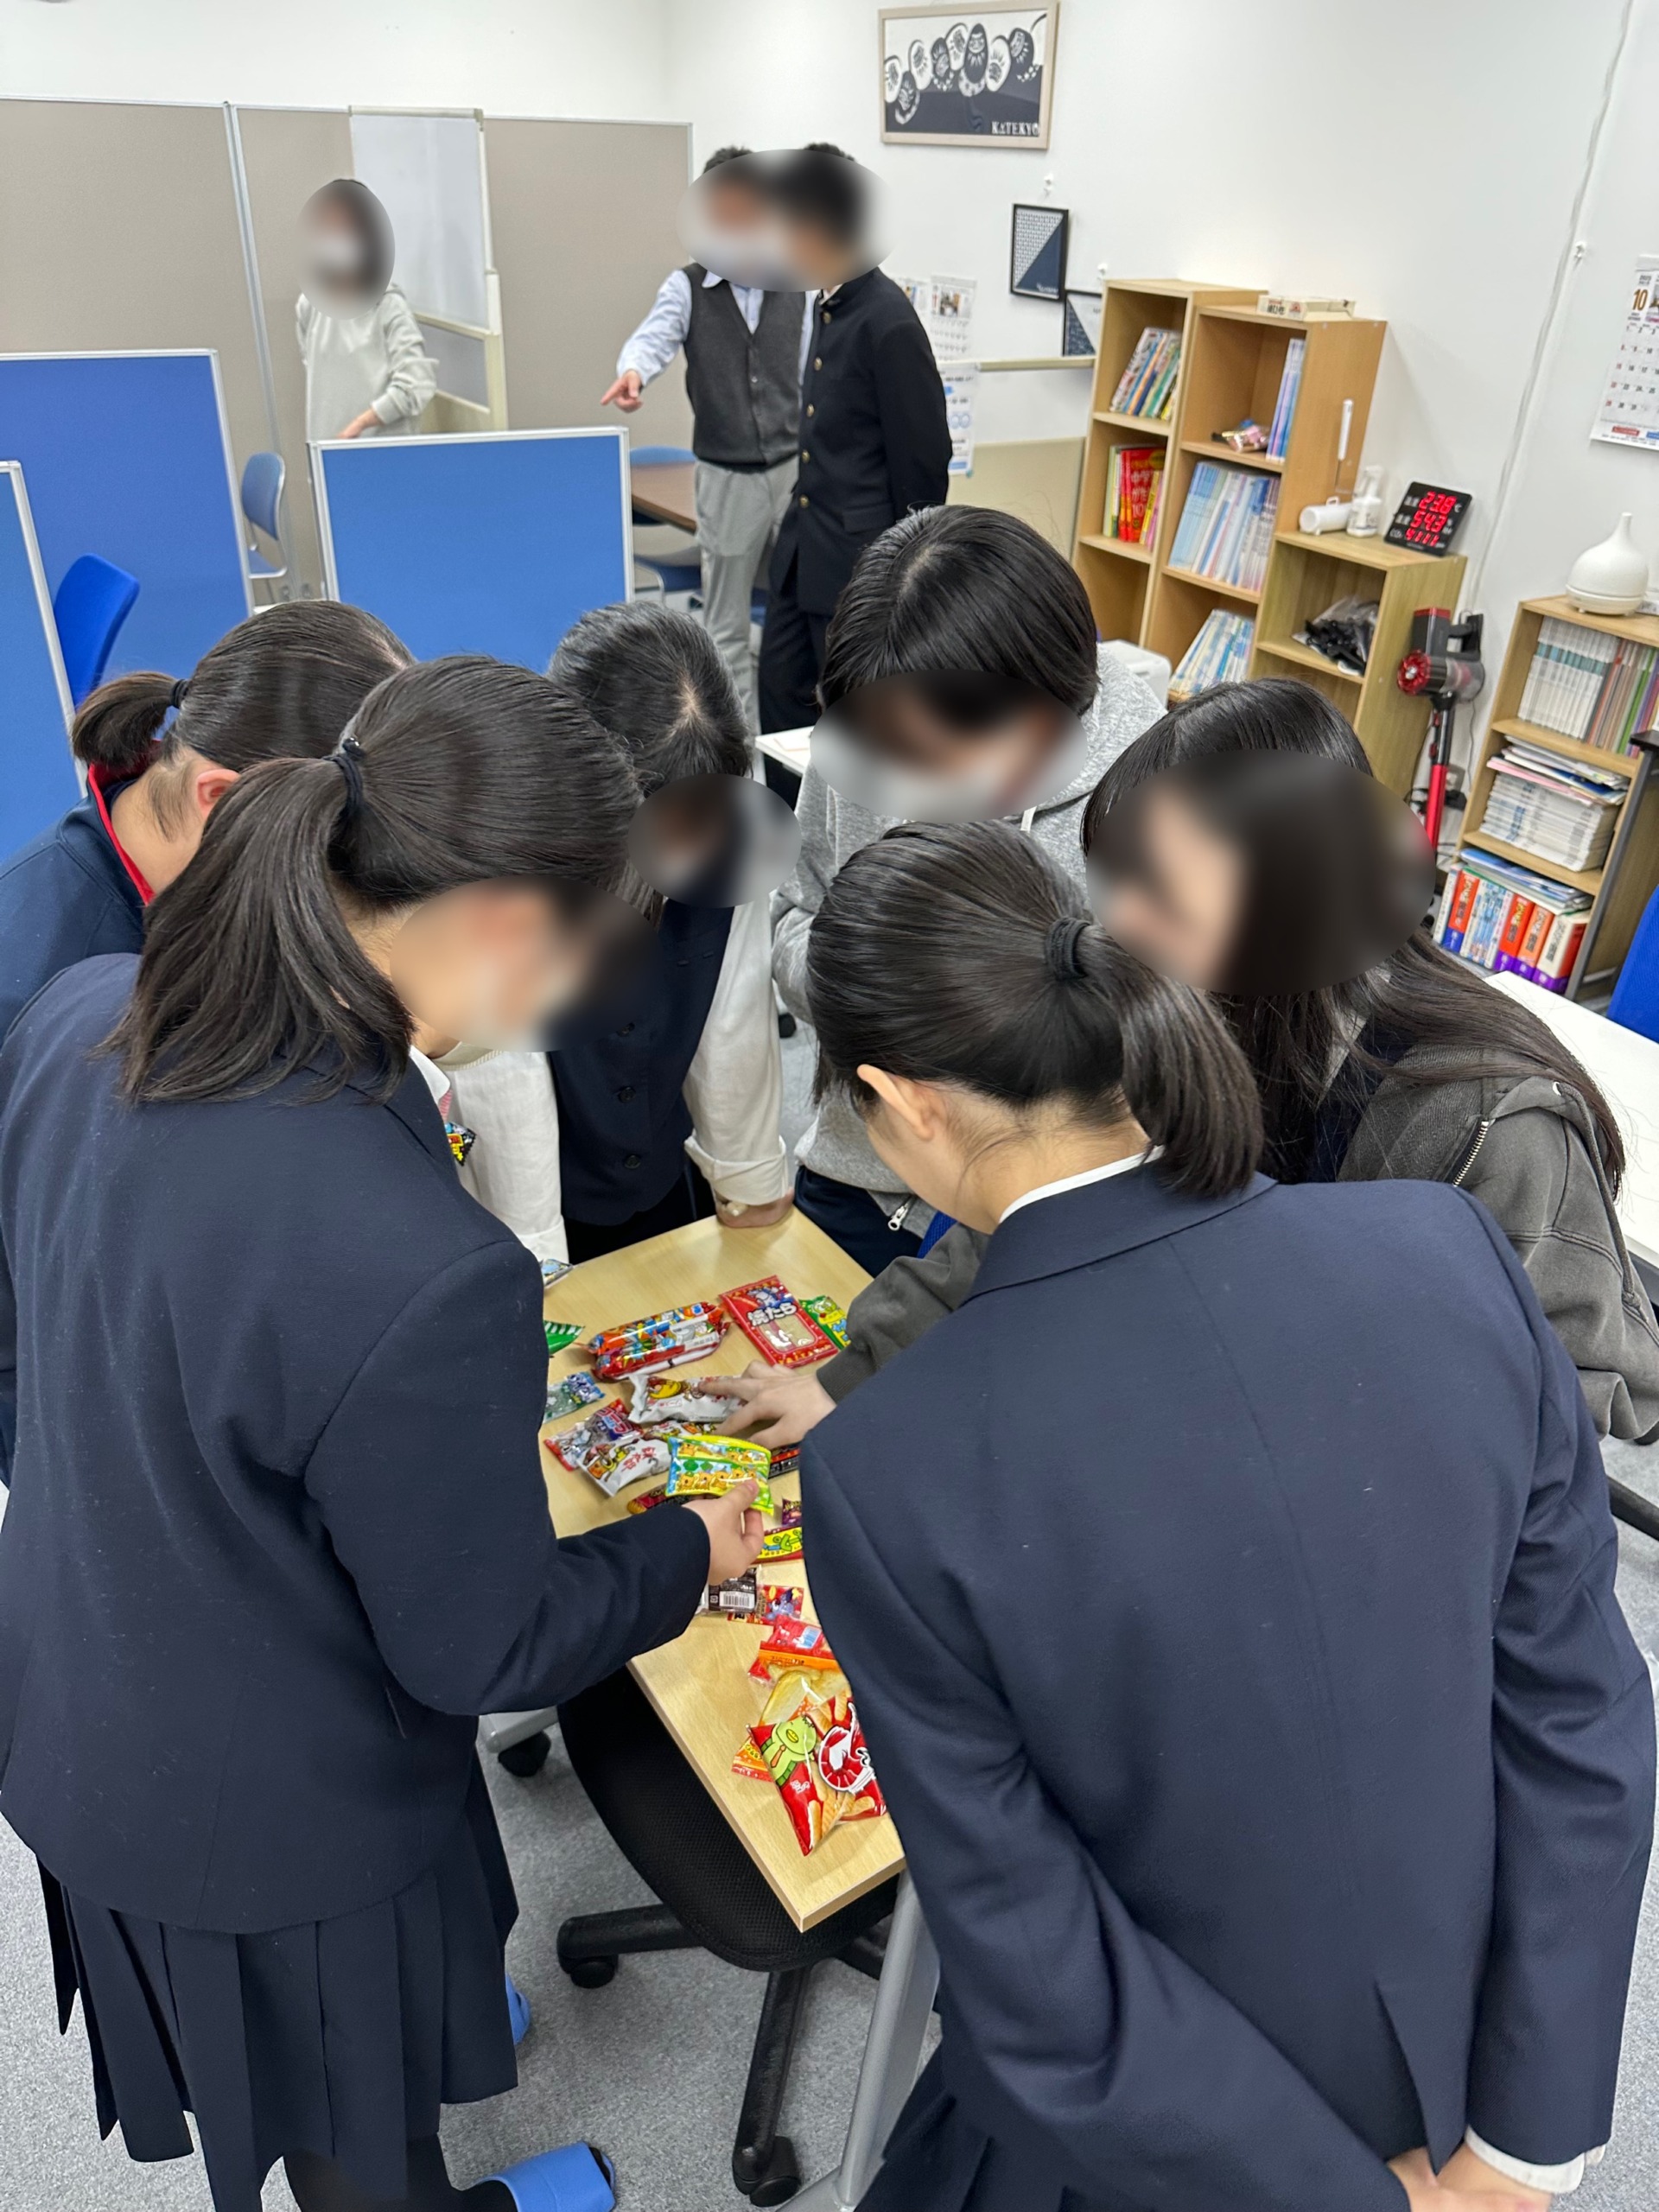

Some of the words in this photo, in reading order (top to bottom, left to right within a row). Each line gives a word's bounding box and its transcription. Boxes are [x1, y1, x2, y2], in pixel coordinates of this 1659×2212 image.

[991, 121, 1039, 136] KATEKYO
[1632, 289, 1649, 311] 10
[594, 1408, 632, 1434] コーラ
